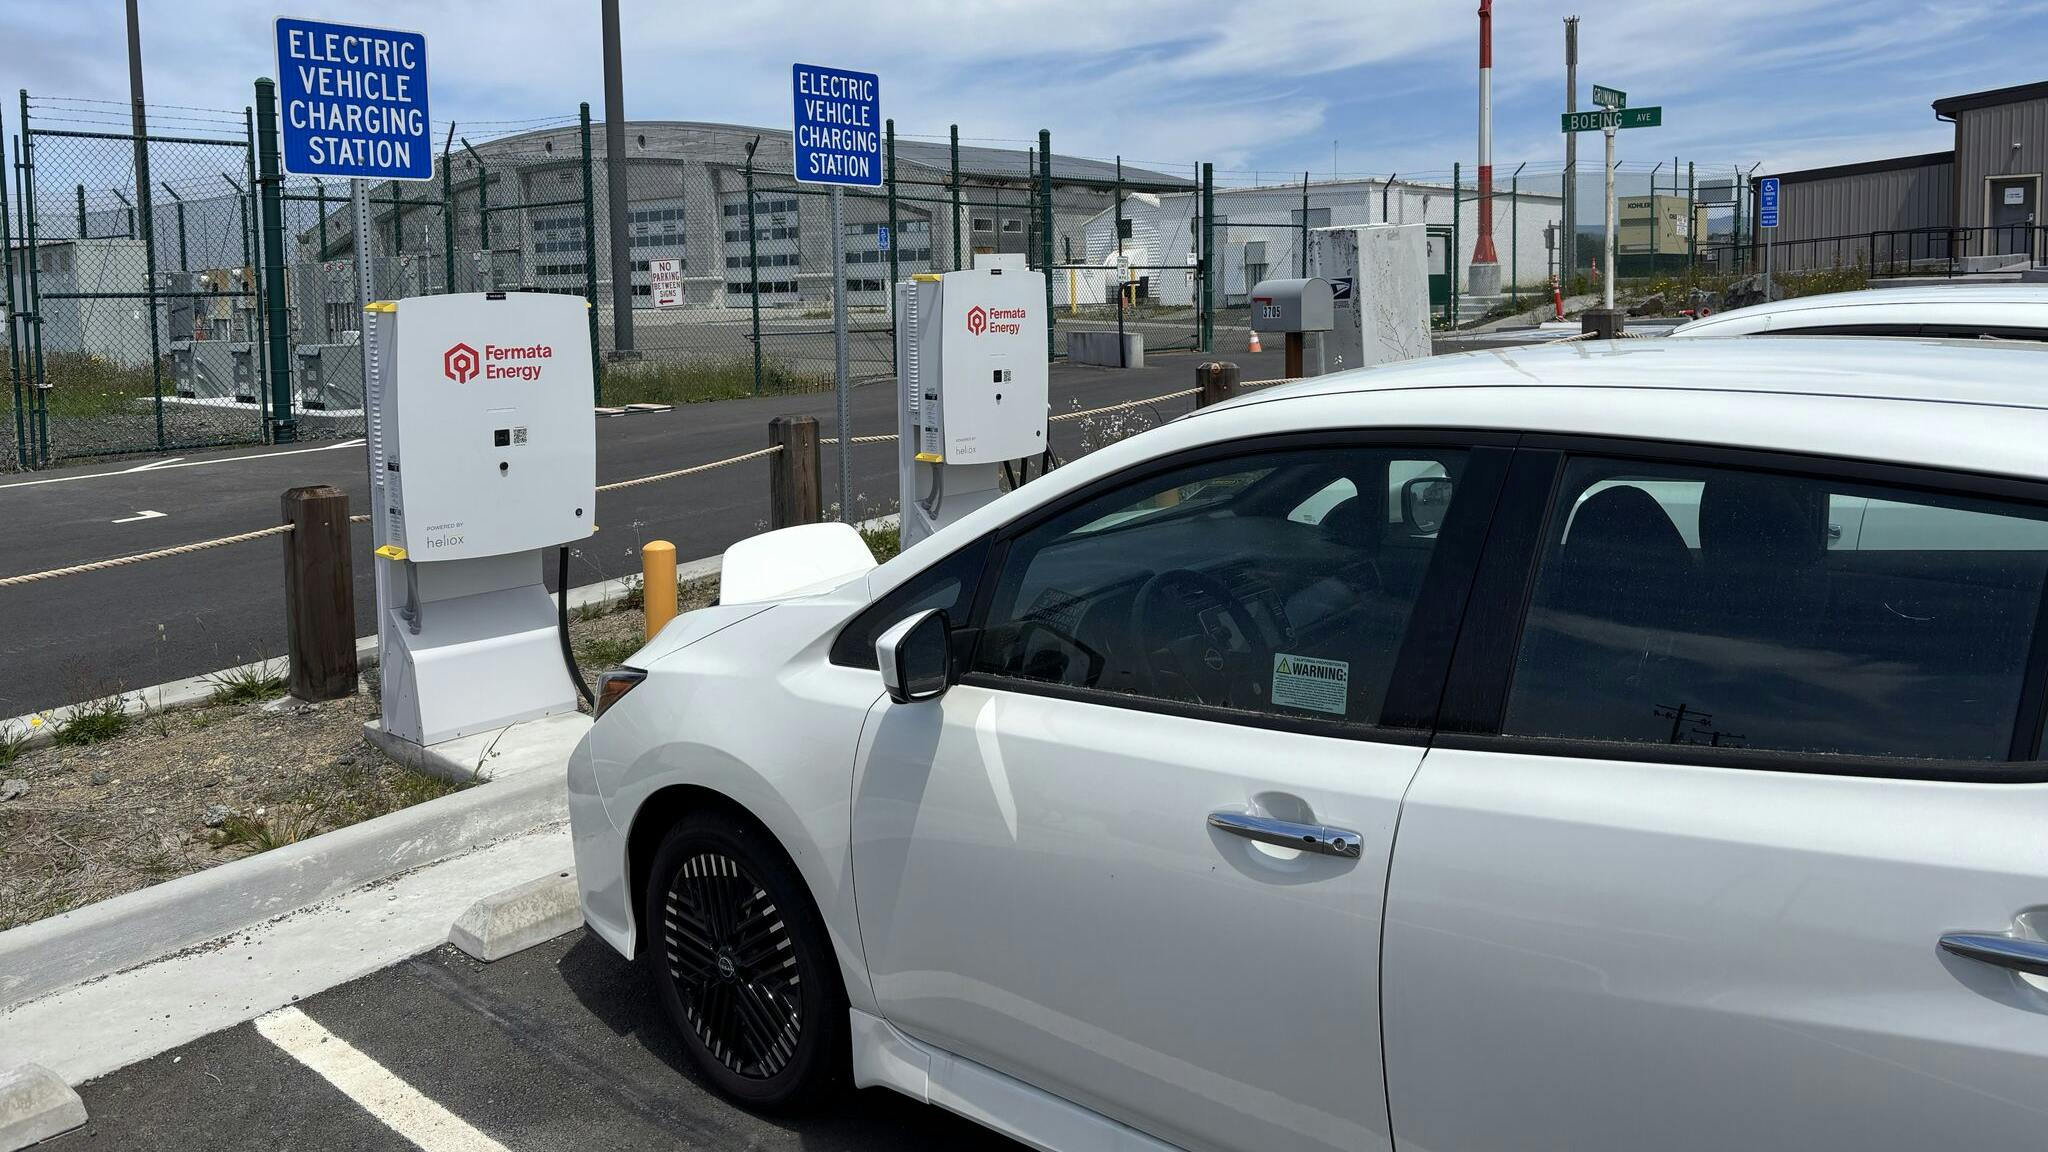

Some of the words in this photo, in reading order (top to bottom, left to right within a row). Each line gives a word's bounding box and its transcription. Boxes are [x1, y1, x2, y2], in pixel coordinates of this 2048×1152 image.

[289, 29, 416, 70] ELECTRIC
[298, 65, 412, 102] VEHICLE
[799, 71, 873, 102] ELECTRIC
[289, 99, 424, 137] CHARGING
[805, 98, 871, 127] VEHICLE
[1570, 112, 1623, 130] BOEING
[1636, 112, 1652, 122] AVE
[799, 124, 877, 153] CHARGING
[309, 136, 411, 169] STATION
[809, 152, 870, 178] STATION
[660, 262, 671, 271] NO
[653, 272, 680, 281] PARKING
[653, 282, 681, 290] BETWEEN
[660, 290, 677, 298] SIGNS
[989, 307, 1026, 320] Fermata
[1263, 306, 1281, 318] 3705
[989, 321, 1020, 335] Energy
[485, 344, 552, 361] Fermata
[486, 363, 542, 381] Energy
[426, 523, 455, 531] POWERED
[426, 533, 464, 549] heliox
[1292, 662, 1346, 682] WARNING:
